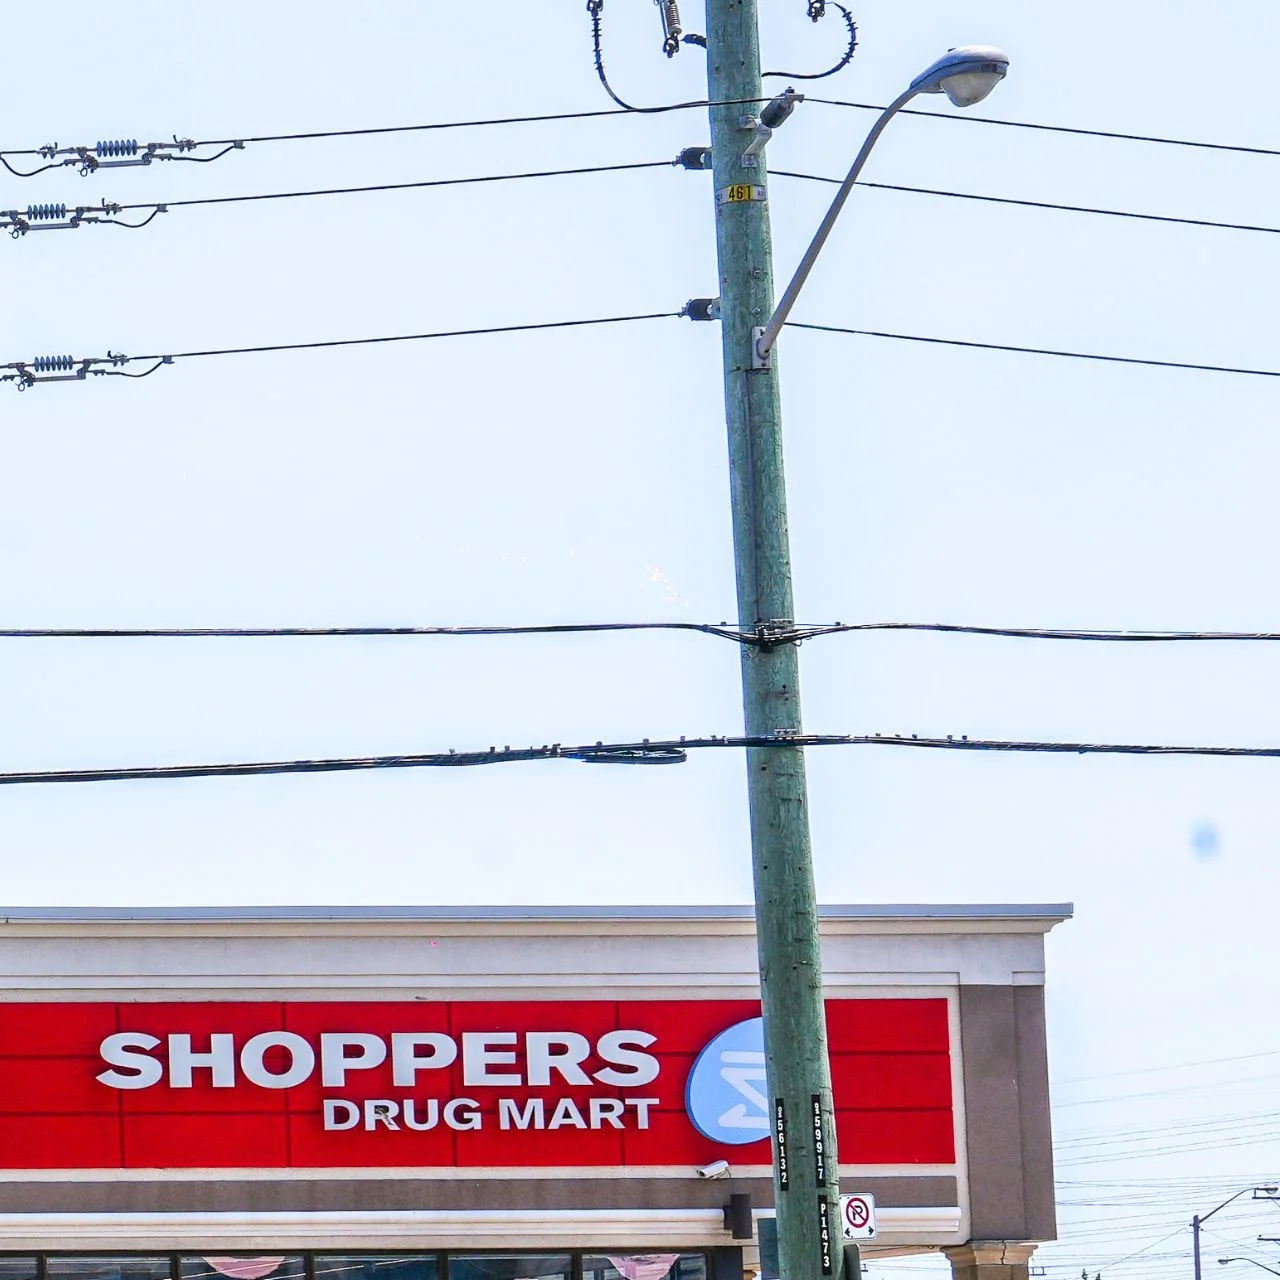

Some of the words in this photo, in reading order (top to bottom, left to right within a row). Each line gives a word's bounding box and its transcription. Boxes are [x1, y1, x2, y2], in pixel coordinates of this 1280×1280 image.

[728, 186, 751, 200] 461
[95, 1029, 661, 1090] SHOPPERS
[322, 1098, 483, 1132] DRUG
[499, 1098, 660, 1131] MART
